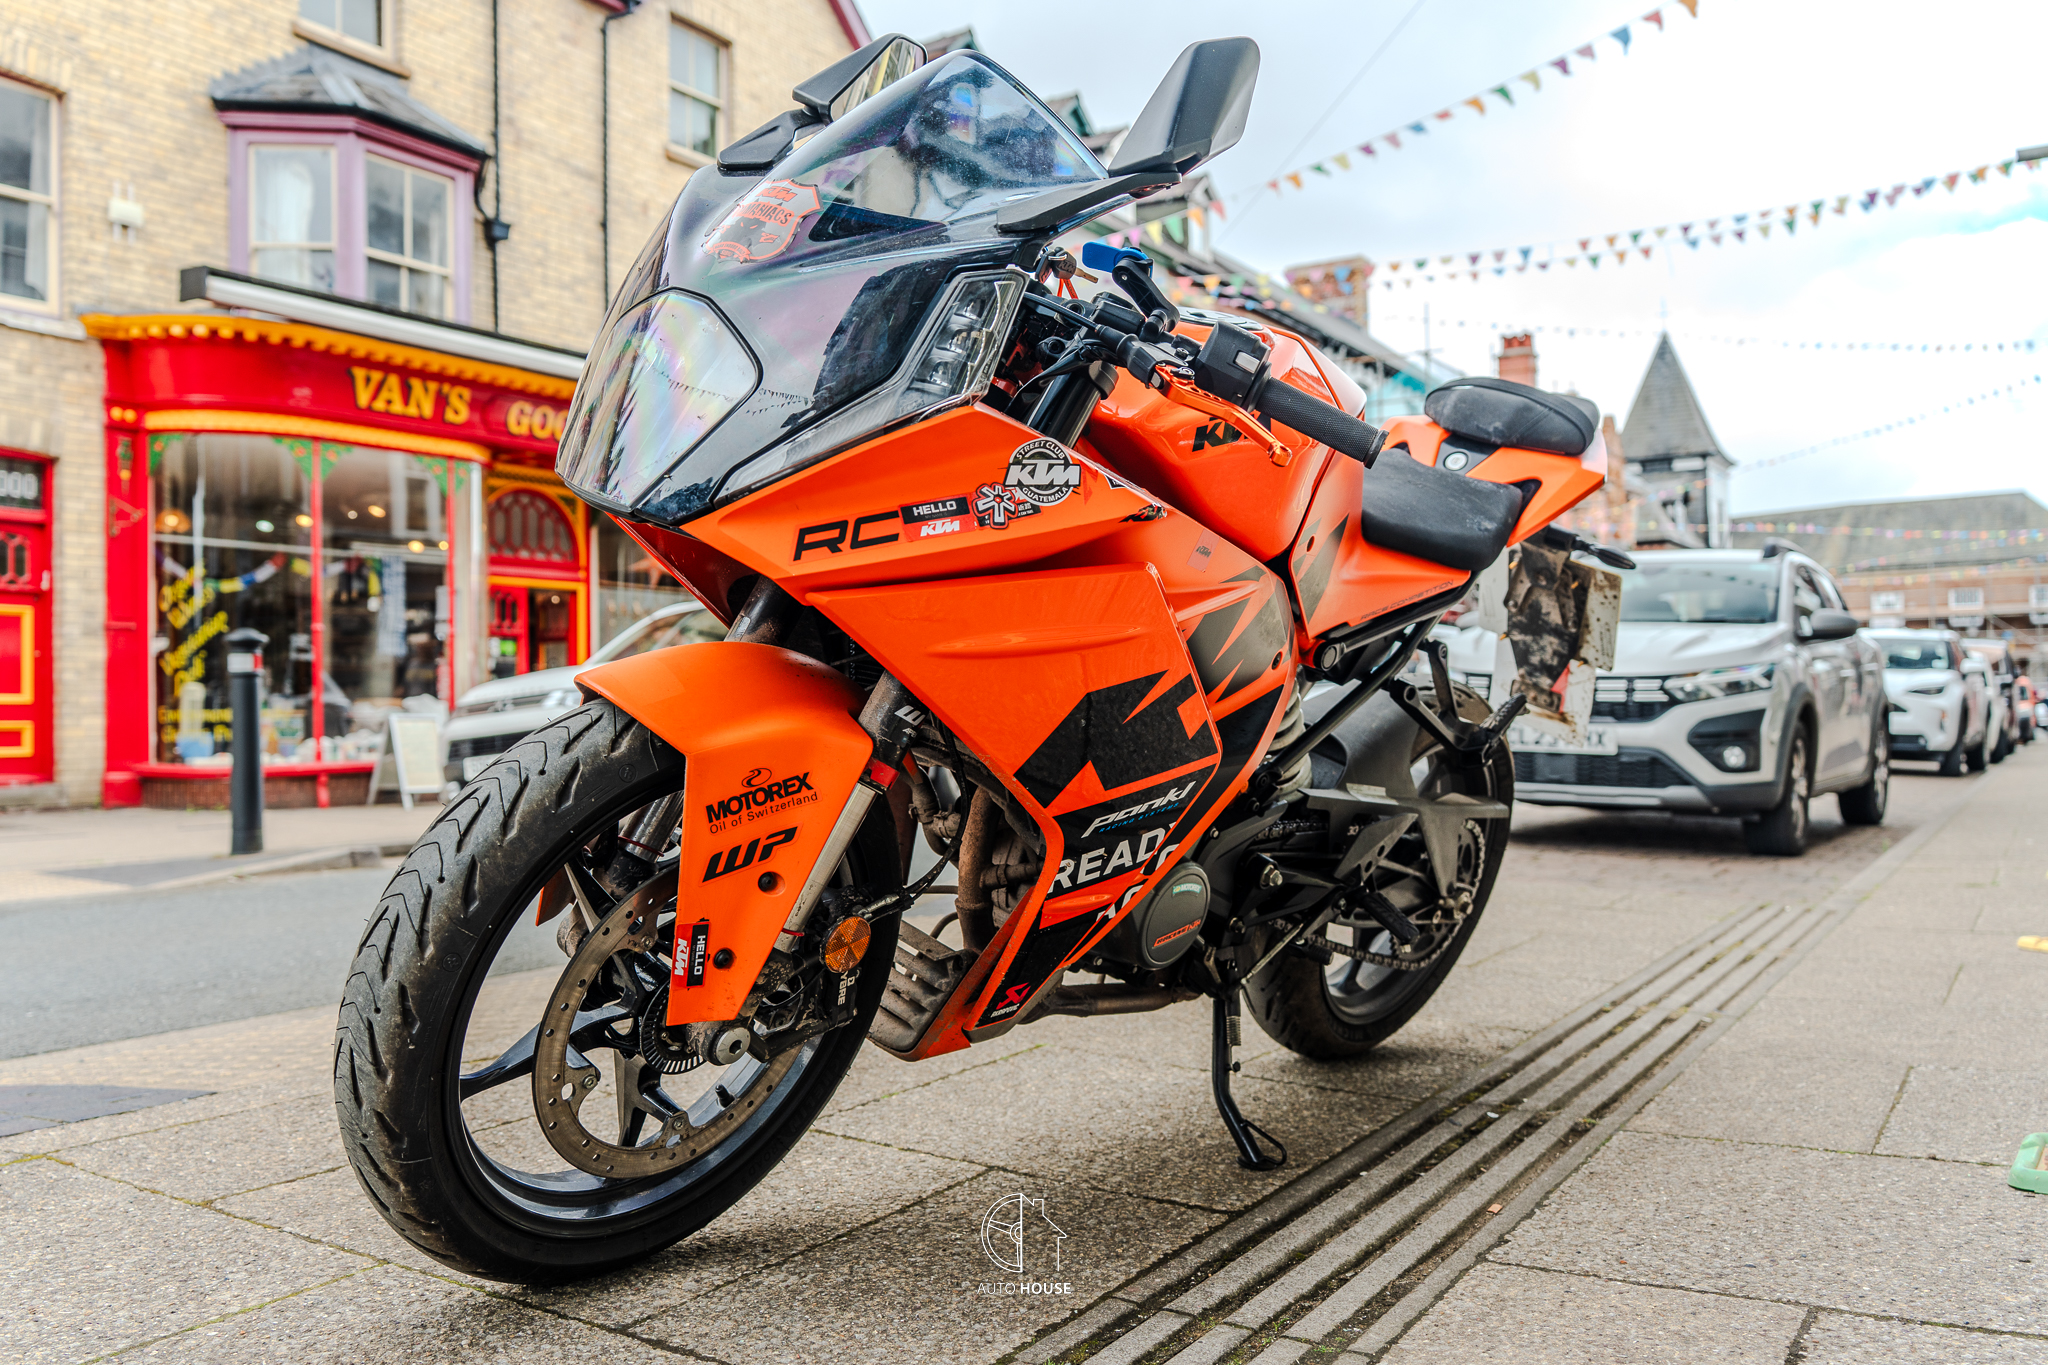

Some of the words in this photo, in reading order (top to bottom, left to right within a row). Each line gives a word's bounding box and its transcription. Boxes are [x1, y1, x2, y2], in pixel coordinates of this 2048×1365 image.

[756, 186, 798, 202] KTM
[741, 203, 792, 225] MANIACS
[348, 366, 472, 425] VAN'S
[1016, 440, 1046, 460] STREET
[1046, 441, 1066, 460] CLUB
[1005, 459, 1080, 485] KTM
[912, 501, 957, 516] HELLO
[1022, 487, 1069, 503] GUATEMALA
[793, 510, 900, 561] RC
[920, 519, 960, 537] KTM
[1196, 545, 1212, 558] KTM
[705, 771, 814, 824] MOTOREX
[709, 822, 727, 834] Oil
[732, 814, 743, 828] of
[747, 791, 818, 821] Switzerland
[1099, 817, 1134, 833] RACING
[1138, 802, 1179, 820] SYSTEMS
[674, 938, 690, 976] KTM
[694, 935, 706, 976] HELLO
[838, 970, 849, 1006] YBRE
